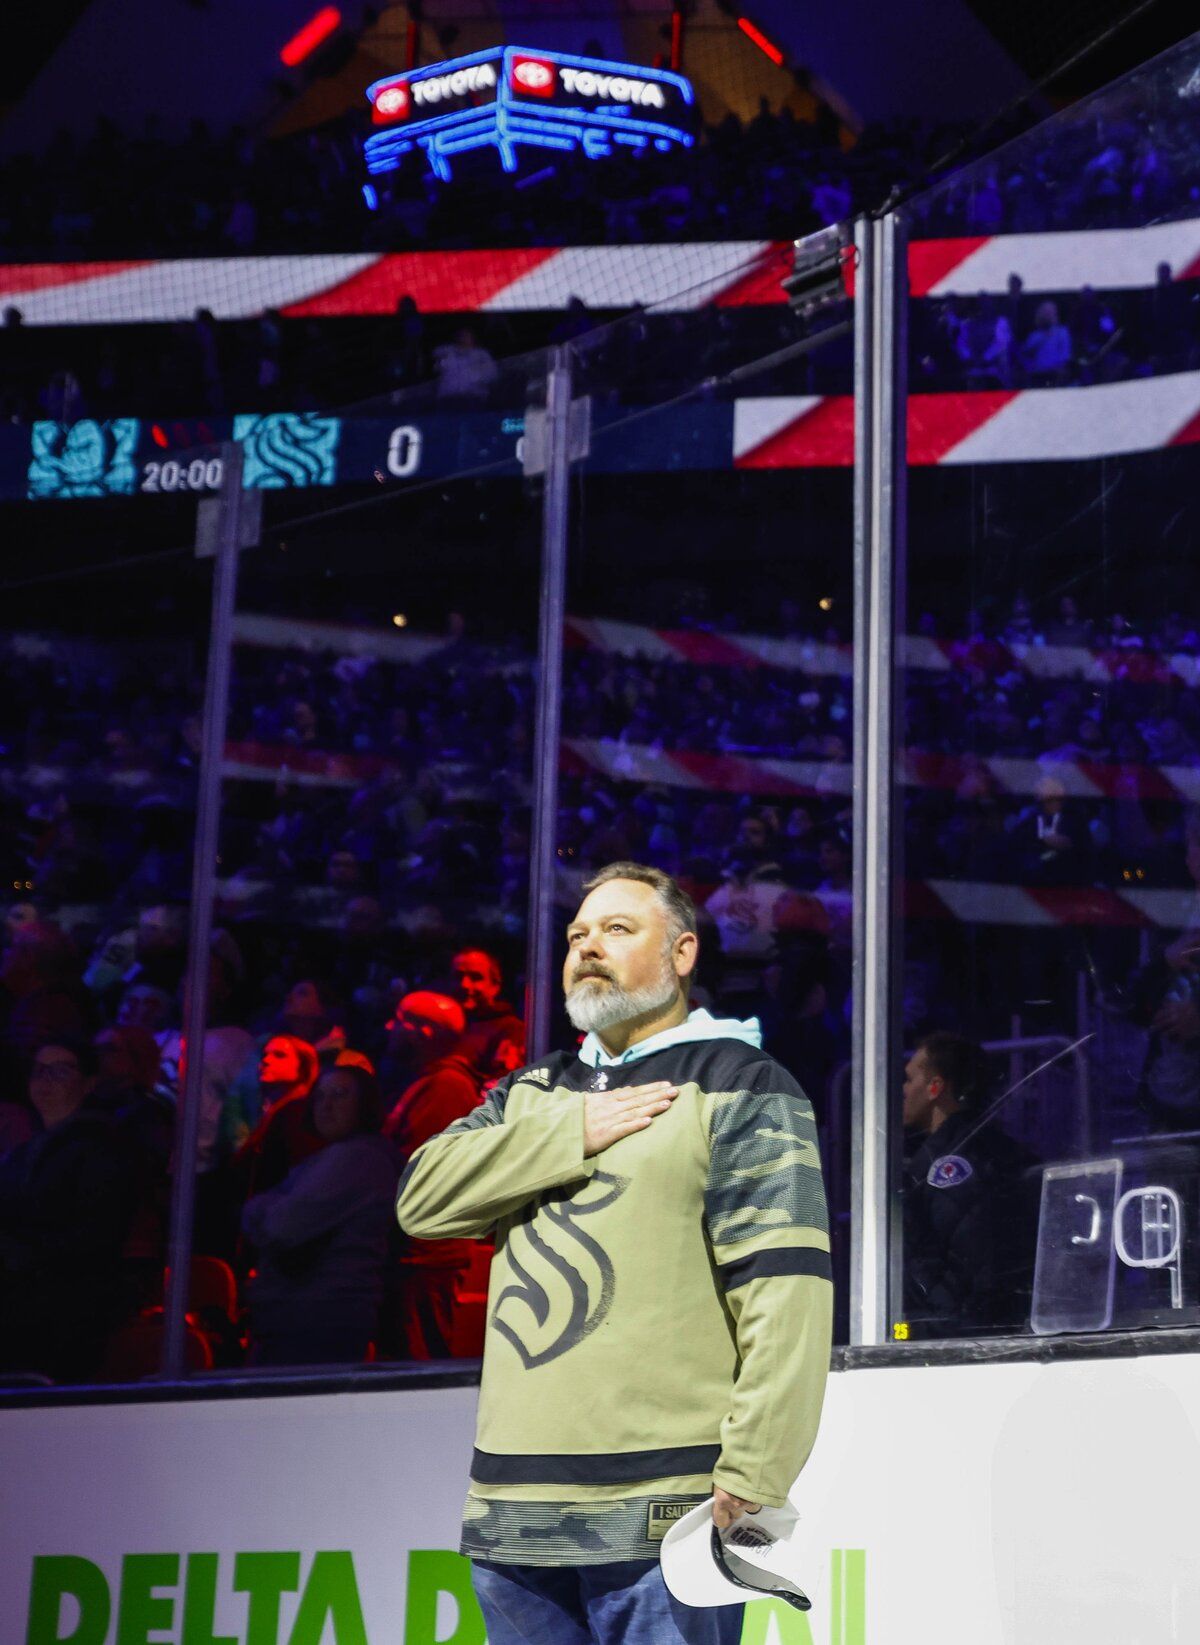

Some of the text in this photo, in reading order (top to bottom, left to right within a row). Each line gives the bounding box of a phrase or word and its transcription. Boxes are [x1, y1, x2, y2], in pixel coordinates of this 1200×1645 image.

[412, 64, 496, 105] TOYOTA
[560, 68, 665, 108] TOYOTA
[388, 425, 421, 476] 0
[141, 459, 223, 492] 20:00
[26, 1550, 369, 1645] DELTA
